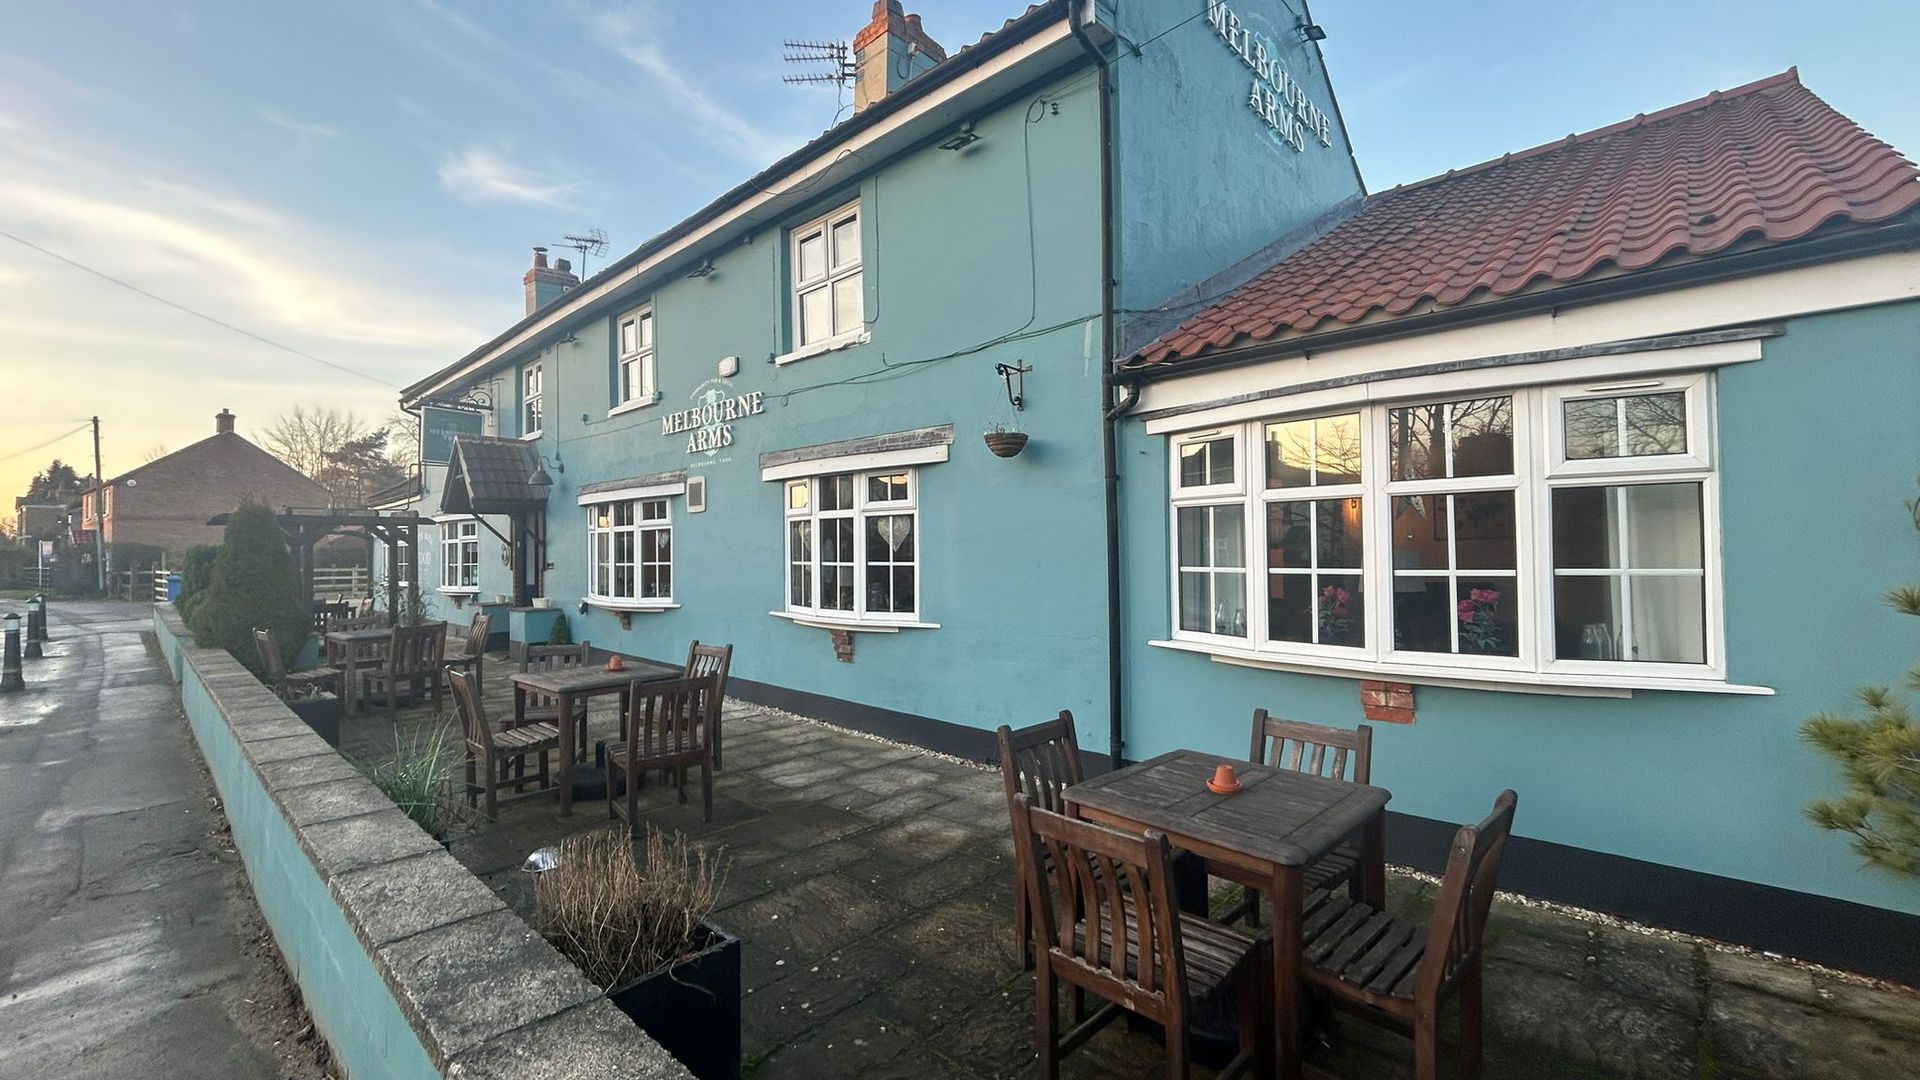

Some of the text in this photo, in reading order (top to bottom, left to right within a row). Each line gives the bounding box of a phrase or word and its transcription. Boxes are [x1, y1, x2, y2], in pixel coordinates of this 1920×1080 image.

[1207, 0, 1331, 148] MELBOURNE
[1249, 79, 1304, 152] ARMS
[662, 391, 763, 435] MELBOURNE
[687, 425, 732, 453] ARMS
